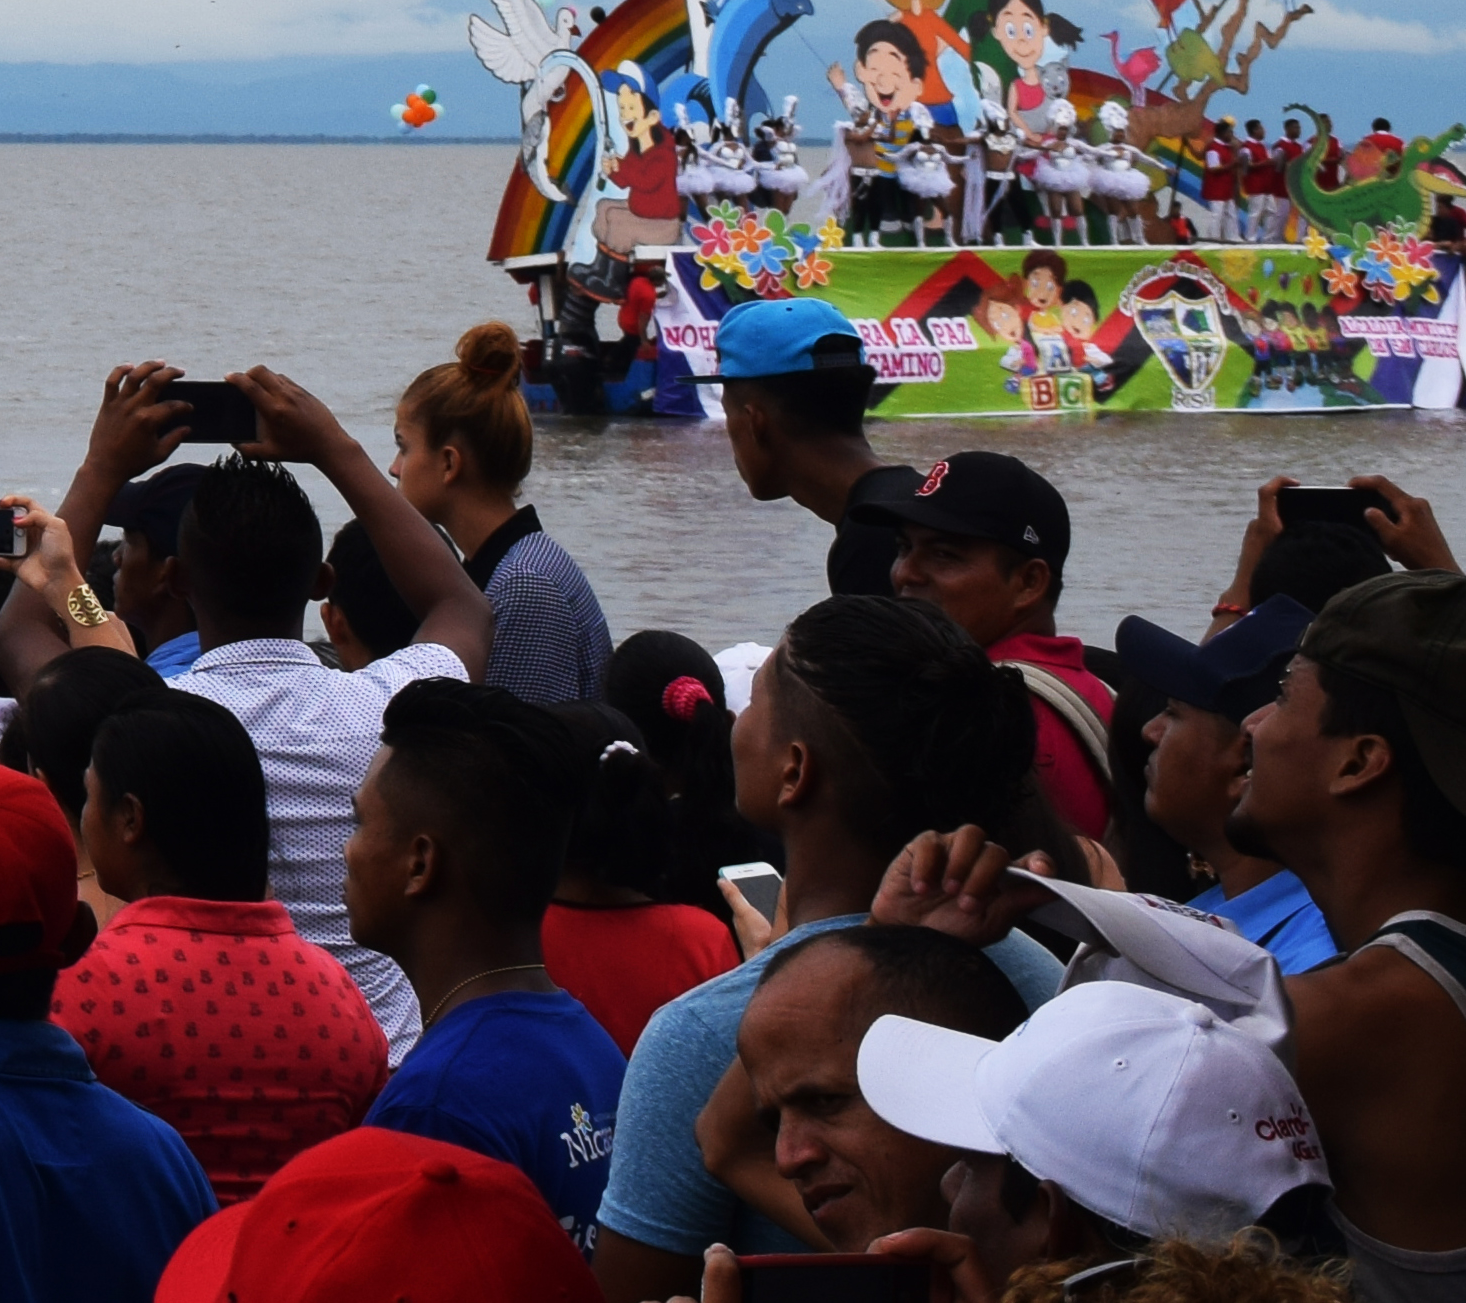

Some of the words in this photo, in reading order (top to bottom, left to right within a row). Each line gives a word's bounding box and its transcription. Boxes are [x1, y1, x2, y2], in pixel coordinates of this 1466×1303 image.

[894, 323, 925, 346] LA
[932, 322, 974, 345] PAZ
[867, 352, 942, 377] CAMINO
[1034, 379, 1053, 406] B
[1063, 379, 1082, 406] C
[915, 461, 949, 496] B
[1255, 1114, 1310, 1141] Claro
